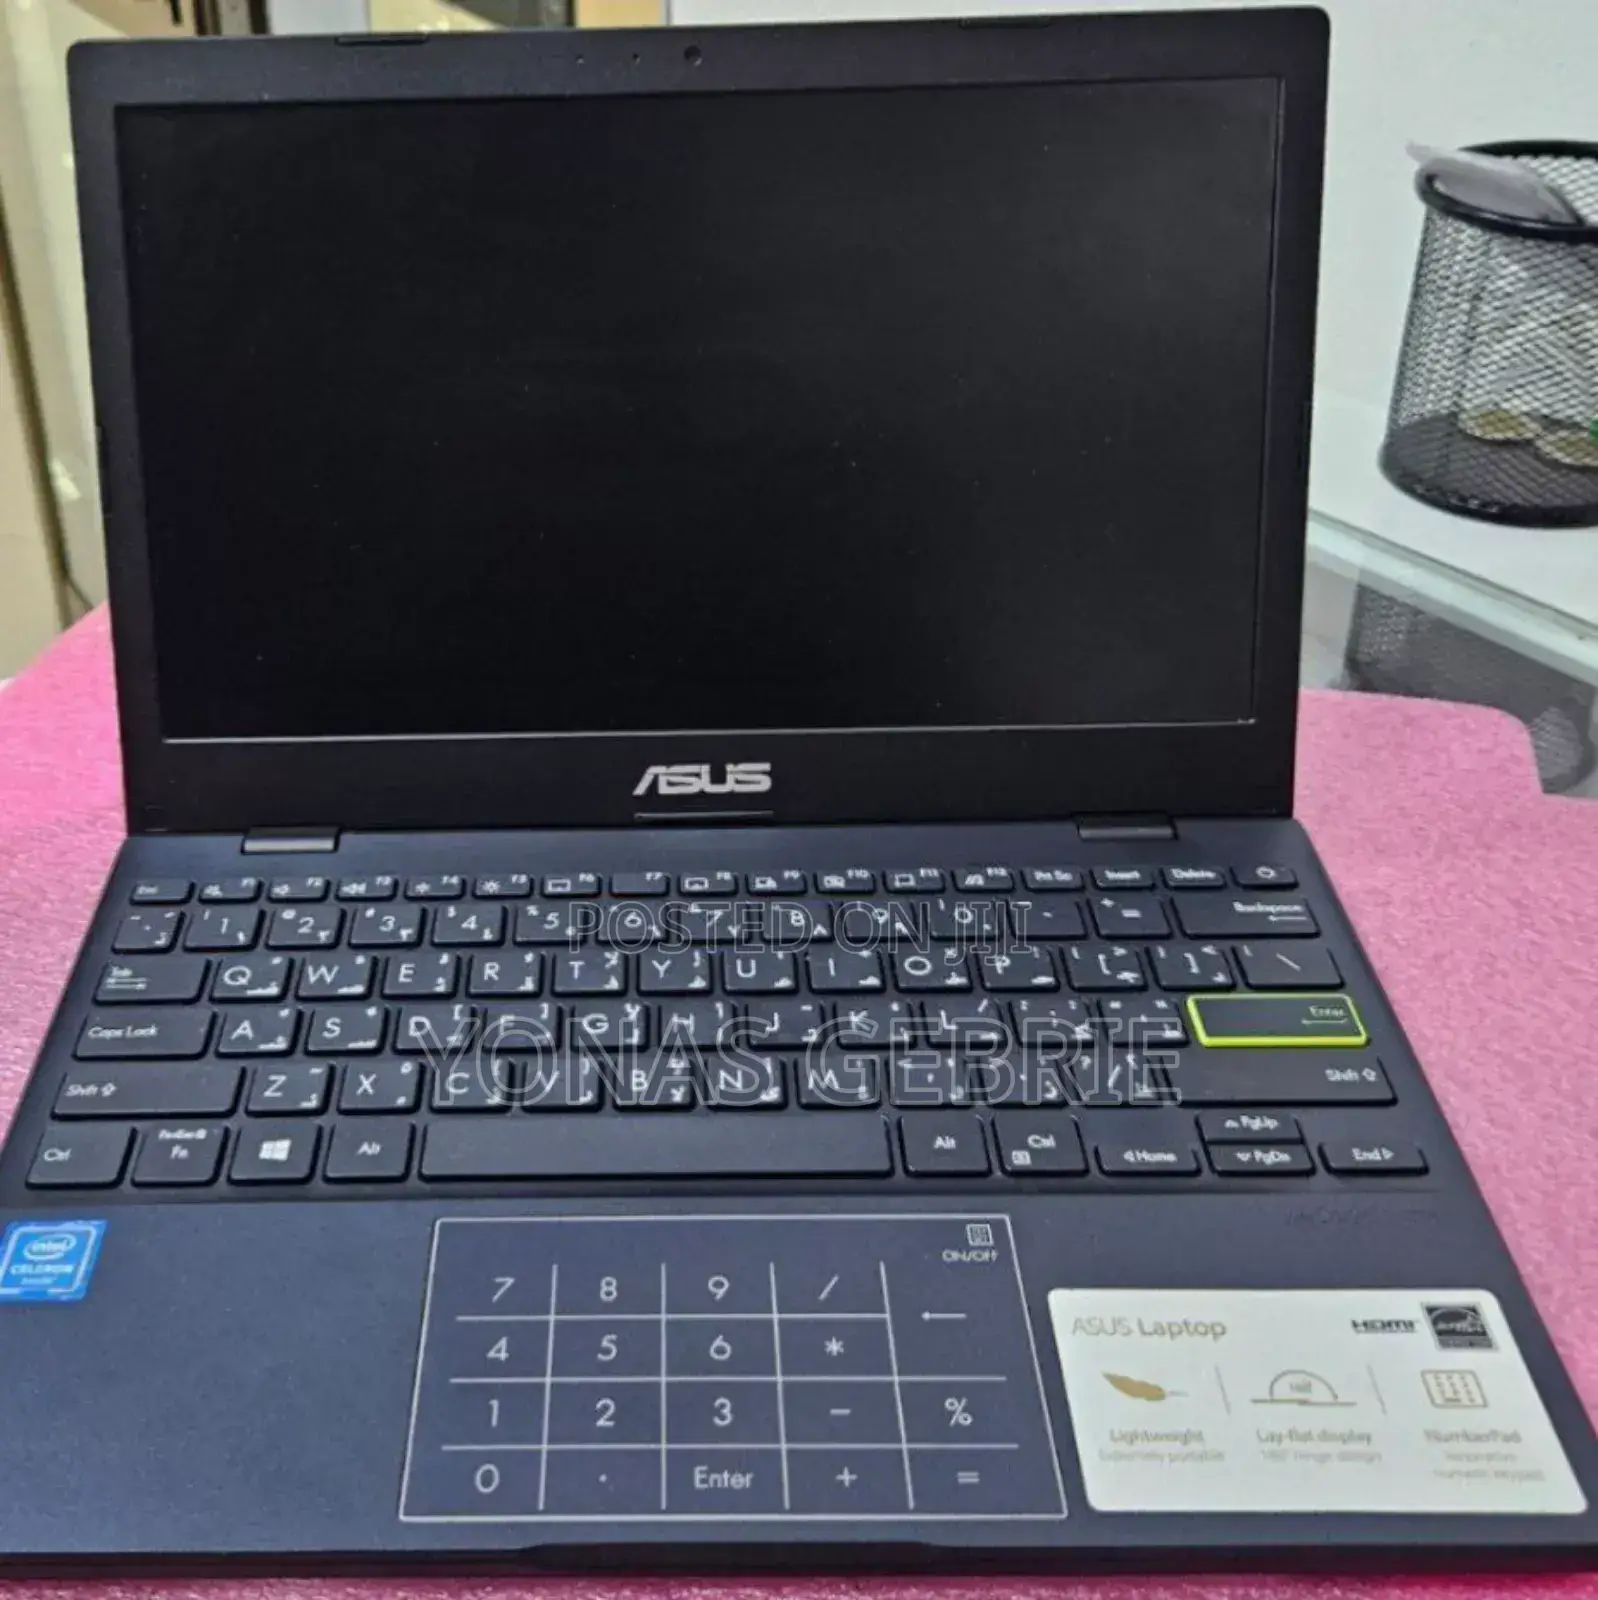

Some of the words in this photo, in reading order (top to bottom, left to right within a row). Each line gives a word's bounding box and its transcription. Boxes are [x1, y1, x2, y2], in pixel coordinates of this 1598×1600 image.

[632, 762, 772, 796] ASUS
[220, 918, 229, 934] 1
[298, 917, 315, 933] 2
[379, 915, 396, 932] 3
[461, 915, 477, 930] 4
[544, 912, 559, 930] 5
[624, 910, 642, 928] 6
[706, 909, 723, 928] 7
[790, 909, 805, 927] 8
[308, 964, 339, 984] W
[398, 963, 415, 983] E
[483, 962, 500, 981] R
[568, 961, 585, 980] T
[652, 959, 671, 978] Y
[736, 959, 756, 978] U
[904, 956, 932, 976] O
[996, 956, 1011, 974] P
[223, 965, 251, 986] Q
[231, 1020, 254, 1040] A
[322, 1017, 342, 1038] S
[409, 1016, 430, 1037] D
[499, 1014, 515, 1036] F
[582, 1013, 609, 1034] G
[671, 1012, 695, 1034] H
[765, 1012, 779, 1032] J
[849, 1010, 871, 1032] K
[940, 1010, 958, 1030] L
[88, 1026, 122, 1040] Caps
[125, 1024, 158, 1038] Lock
[263, 1075, 287, 1098] Z
[356, 1074, 377, 1096] X
[445, 1072, 470, 1094] C
[539, 1071, 560, 1091] V
[631, 1069, 647, 1092] B
[719, 1069, 742, 1090] N
[808, 1068, 839, 1090] M
[170, 1144, 189, 1159] Fn
[358, 1142, 380, 1155] Alt
[934, 1136, 956, 1148] Alt
[1027, 1135, 1056, 1148] Ctrl
[43, 1148, 72, 1162] Ctrl
[1136, 1151, 1177, 1162] Home
[1352, 1148, 1381, 1160] End
[942, 1249, 997, 1262] ON/OFF
[492, 1277, 515, 1303] 7
[600, 1276, 617, 1301] 8
[708, 1276, 729, 1300] 9
[819, 1275, 839, 1300] /
[1072, 1316, 1134, 1336] ASUS
[1136, 1317, 1228, 1343] Laptop
[486, 1337, 510, 1361] 4
[597, 1334, 617, 1361] 5
[709, 1335, 731, 1360] 6
[488, 1400, 499, 1427] 1
[595, 1398, 615, 1427] 2
[713, 1398, 733, 1427] 3
[944, 1398, 973, 1427] %
[1110, 1428, 1205, 1446] Lightweight
[1424, 1427, 1522, 1444] NumberPad
[475, 1464, 499, 1494] 0
[693, 1466, 753, 1490] Enter
[836, 1467, 857, 1487] +
[957, 1472, 980, 1484] =
